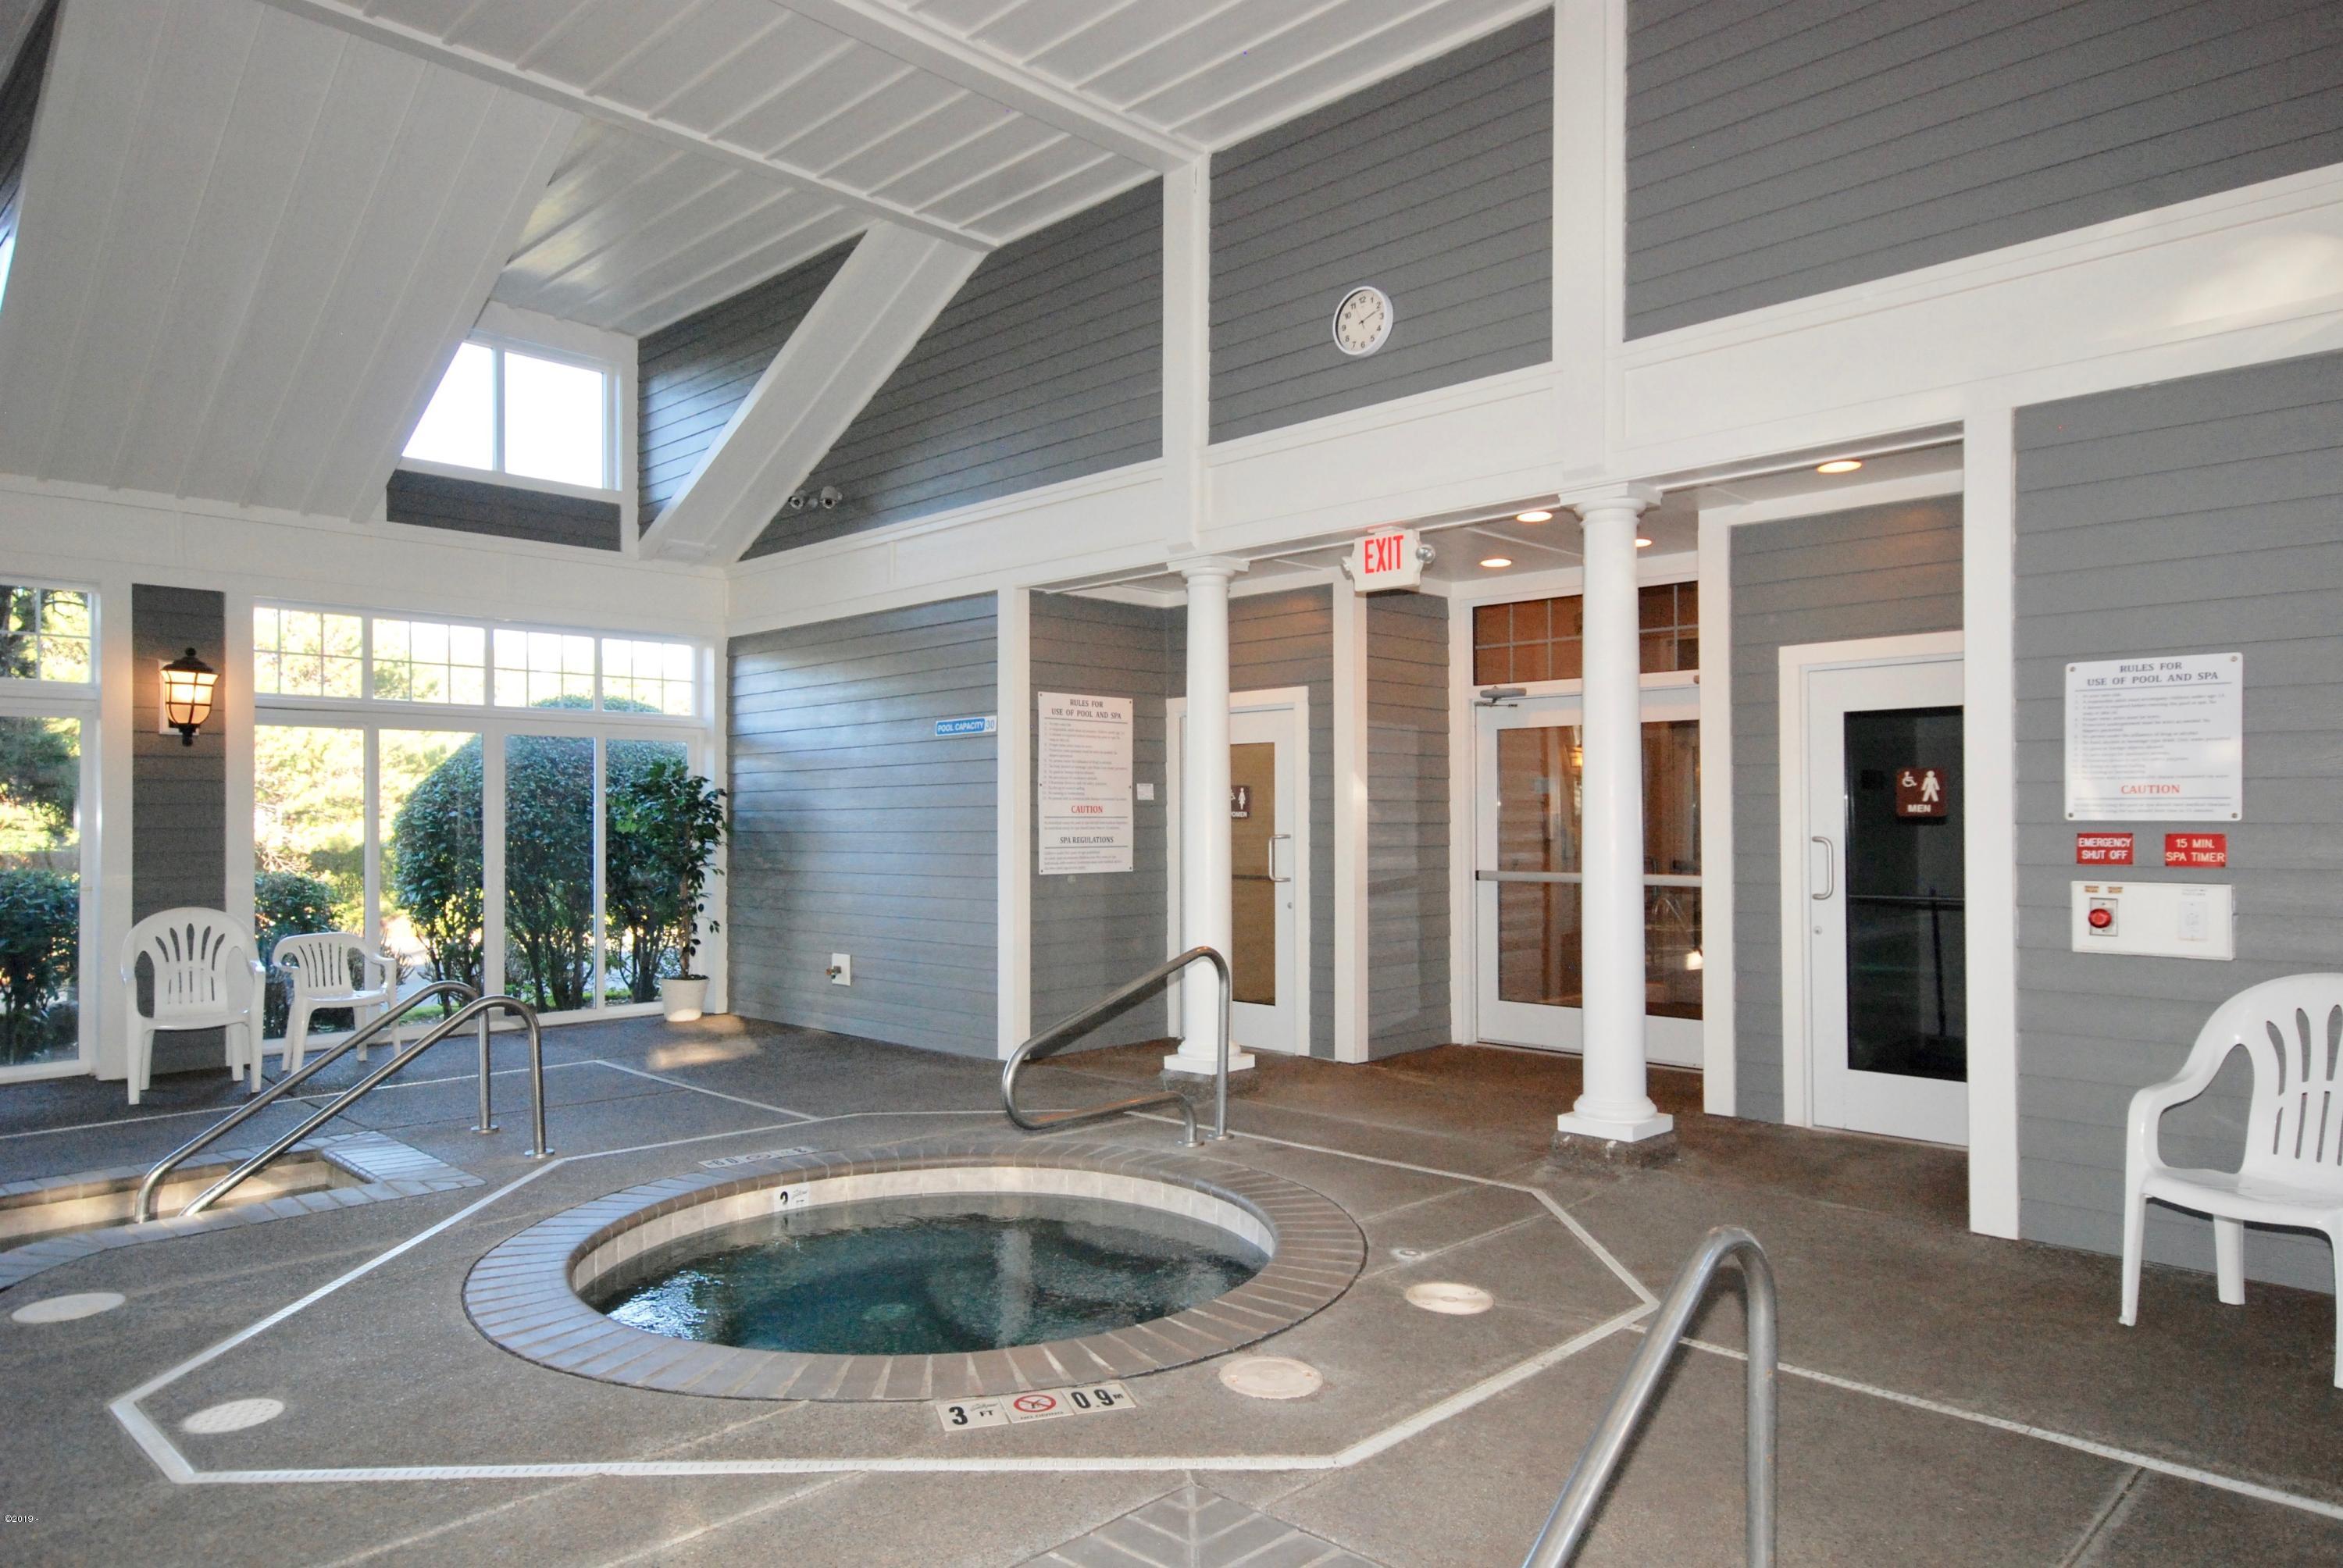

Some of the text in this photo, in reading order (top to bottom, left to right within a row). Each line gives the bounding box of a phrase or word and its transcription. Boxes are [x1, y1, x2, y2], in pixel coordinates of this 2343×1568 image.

[1364, 535, 1404, 574] EXIT
[2120, 661, 2183, 673] RULES FOR
[2087, 671, 2219, 686] USE OF POOL AND SPA
[1051, 707, 1063, 716] USE
[938, 724, 954, 732] POOL
[955, 721, 984, 731] CAPACITY
[2120, 784, 2181, 794] CAUTION
[1071, 805, 1104, 814] CAUTION
[1907, 804, 1931, 813] MEN
[2078, 837, 2131, 847] EMERGENCY
[2175, 839, 2215, 849] 15 MIN.
[2081, 850, 2128, 860] SHUT OFF
[2166, 851, 2225, 863] SPA TIMER
[949, 1406, 995, 1426] 3 FT
